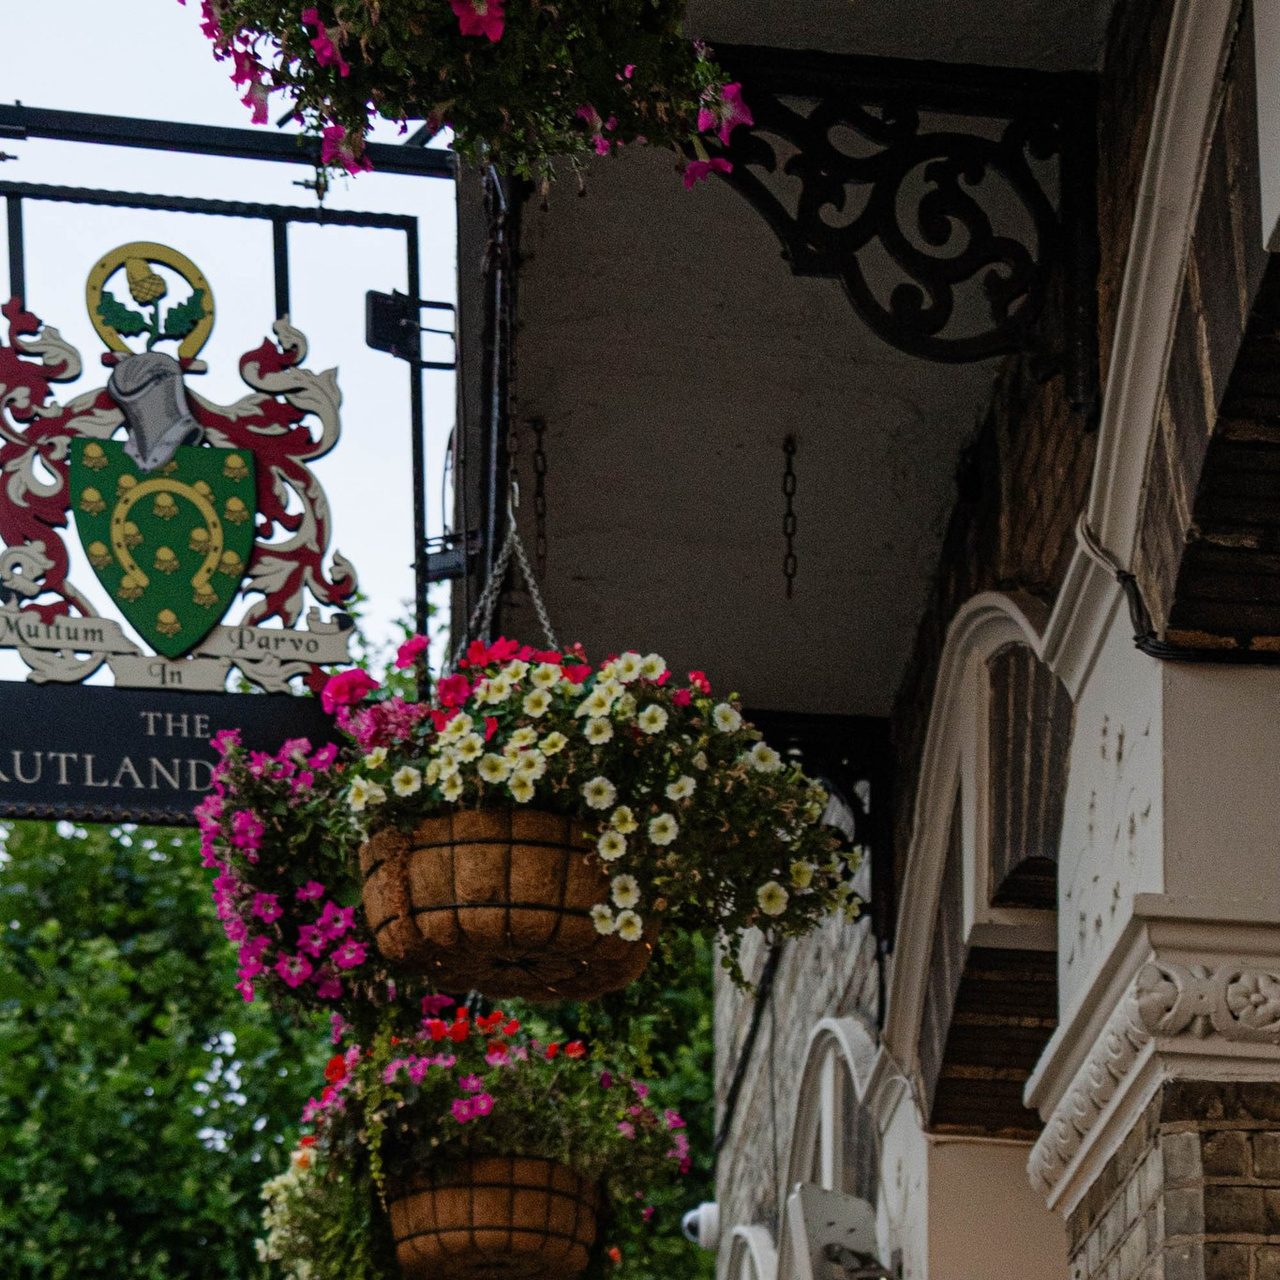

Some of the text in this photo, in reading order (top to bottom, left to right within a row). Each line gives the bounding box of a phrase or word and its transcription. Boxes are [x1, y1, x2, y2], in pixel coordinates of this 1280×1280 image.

[227, 627, 319, 654] Parvo
[149, 663, 182, 685] In
[140, 711, 211, 738] THE
